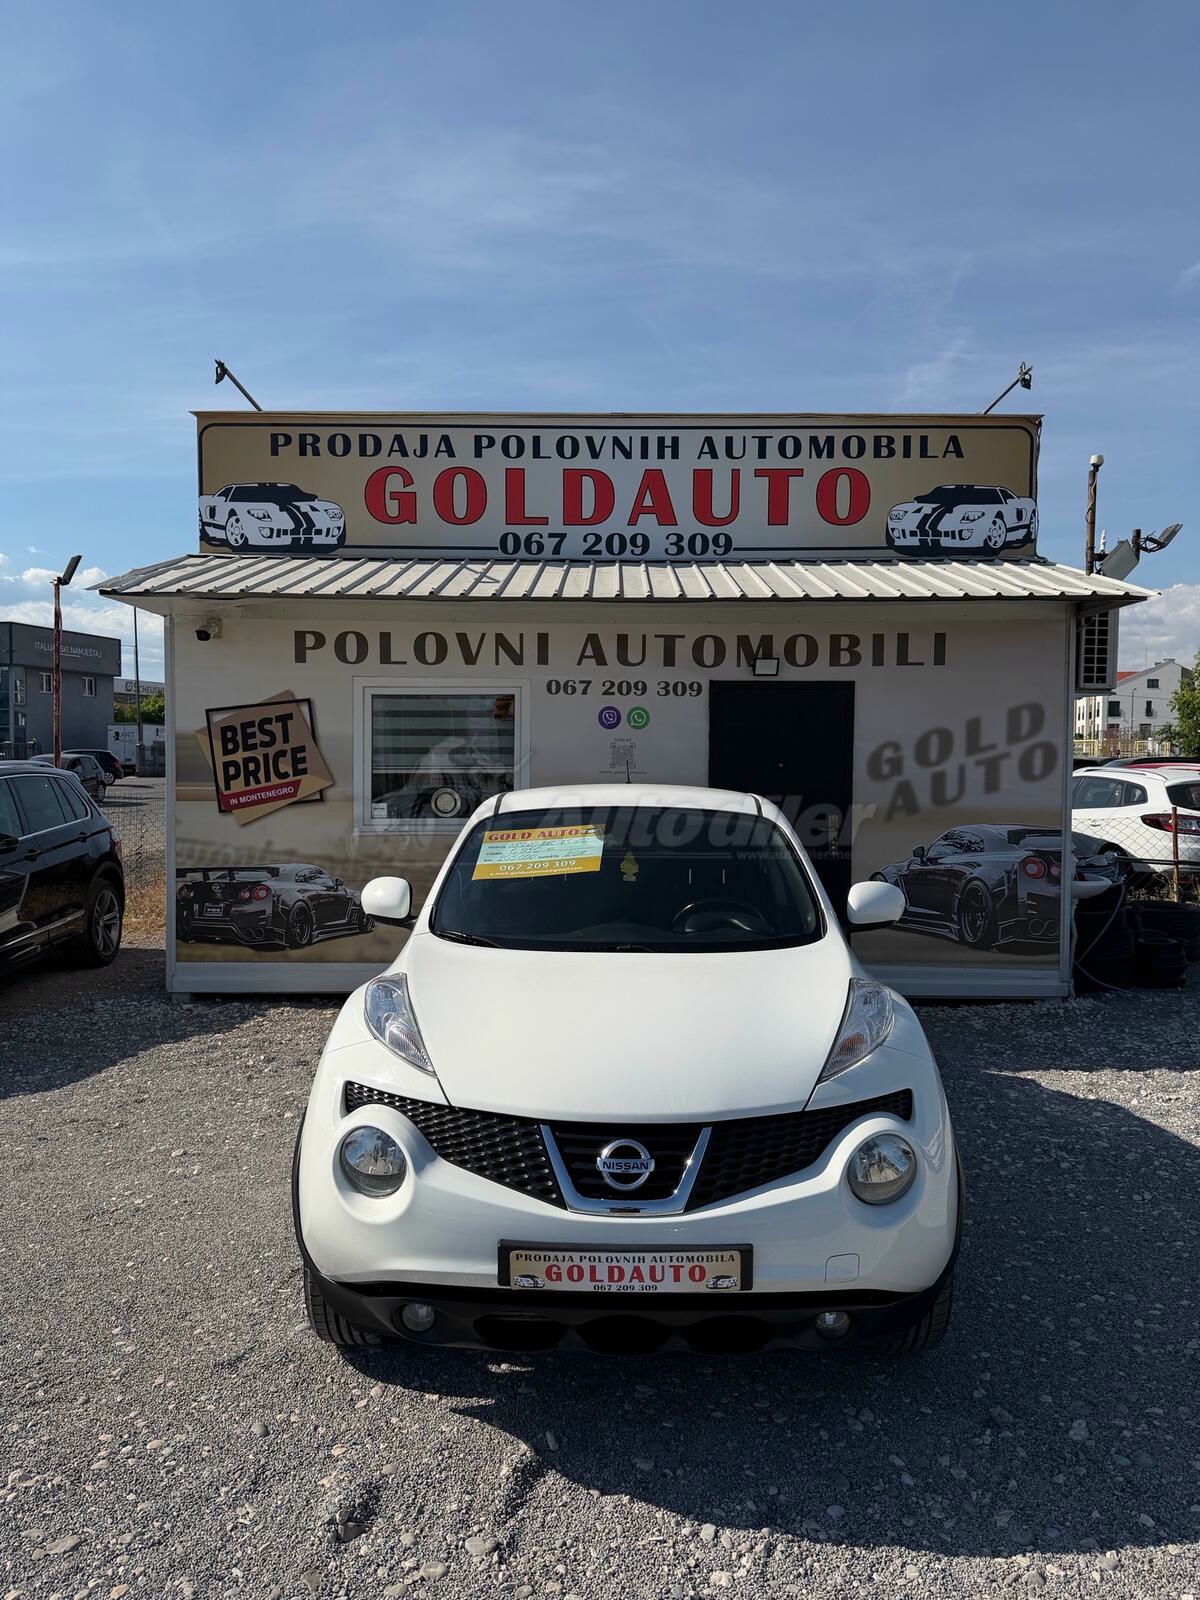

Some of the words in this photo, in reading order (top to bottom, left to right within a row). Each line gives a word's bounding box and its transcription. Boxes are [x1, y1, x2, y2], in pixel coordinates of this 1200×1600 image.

[270, 432, 456, 459] PRODAJA
[474, 434, 679, 460] POLOVNIH
[698, 433, 965, 459] AUTOMOBILA
[364, 465, 871, 526] GOLDAUTO
[499, 532, 568, 556] 067
[582, 532, 650, 556] 209
[665, 532, 734, 556] 309
[294, 629, 549, 666] POLOVNI
[576, 632, 947, 668] AUTOMOBILI
[546, 679, 592, 697] 067
[601, 679, 648, 697] 209
[657, 680, 703, 697] 309
[220, 712, 294, 757] BEST
[866, 702, 1045, 783] GOLD
[222, 744, 308, 791] PRICE
[885, 740, 1059, 823] AUTO
[230, 797, 238, 805] IN
[240, 786, 294, 803] MONTENEGRO
[488, 831, 532, 841] GOLD
[537, 828, 579, 839] AUTO
[499, 863, 523, 871] 067
[526, 861, 549, 869] 209
[552, 859, 577, 868] 309
[602, 1161, 649, 1170] NISSAN
[515, 1253, 575, 1263] PRODAJA
[579, 1254, 646, 1264] POLOVNIH
[650, 1254, 736, 1264] AUTOMOBILA
[544, 1264, 707, 1283] GOLDAUTO
[593, 1284, 613, 1292] 067
[616, 1284, 636, 1292] 209
[638, 1284, 658, 1292] 309
